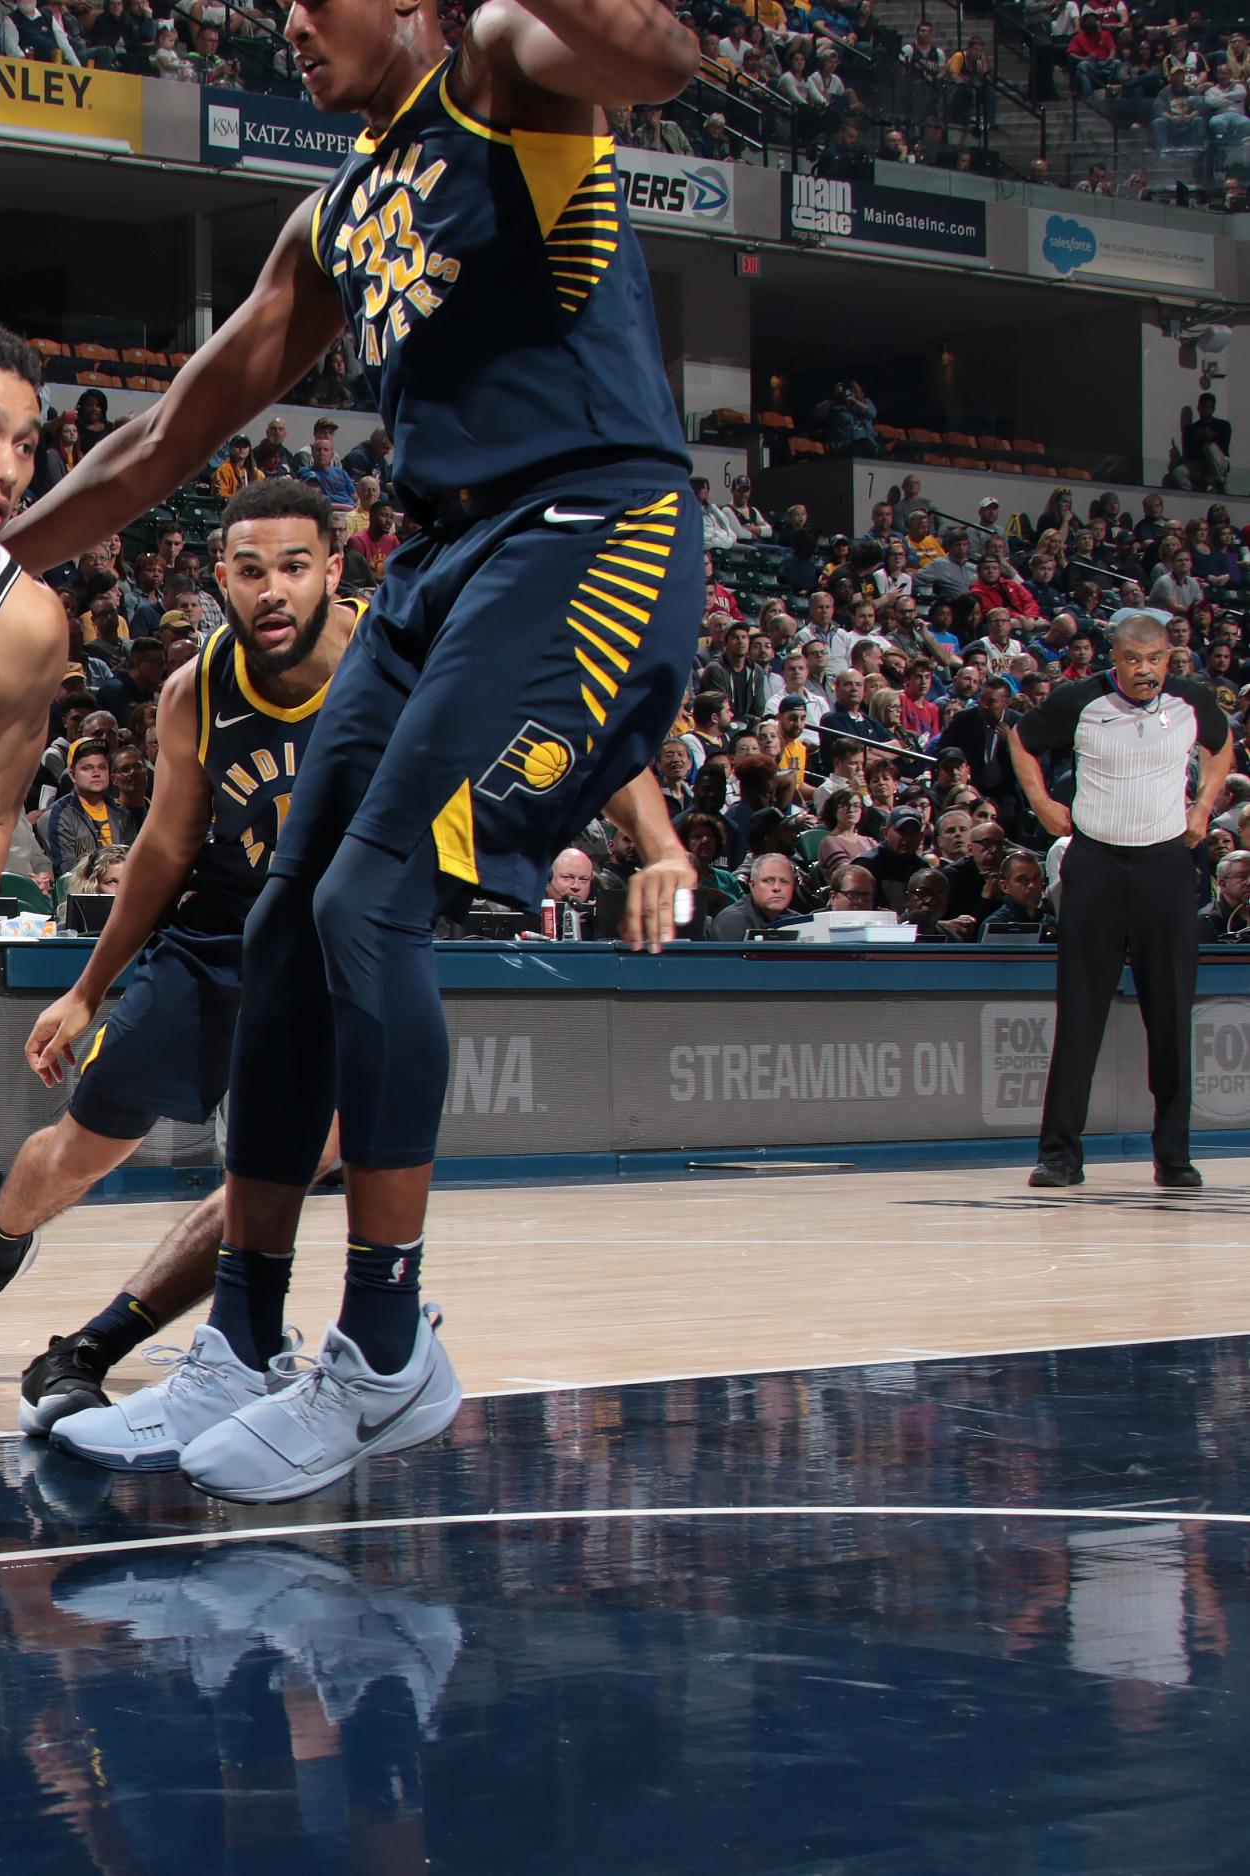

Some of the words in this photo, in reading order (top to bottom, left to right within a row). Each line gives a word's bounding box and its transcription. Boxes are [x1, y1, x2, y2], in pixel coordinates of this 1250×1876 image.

[213, 118, 239, 136] KSM
[244, 122, 291, 147] KATZ
[863, 207, 976, 238] MainGateInc.com
[349, 186, 426, 319] 33
[1050, 236, 1092, 252] salesforce
[741, 255, 759, 274] EXIT
[724, 461, 732, 488] 6
[867, 472, 875, 499] 7
[995, 1017, 1048, 1053] FOX
[442, 1035, 535, 1114] NA
[669, 1042, 902, 1102] STREAMING
[913, 1042, 965, 1096] ON
[994, 1055, 1049, 1071] SPORTS
[996, 1072, 1047, 1109] GO
